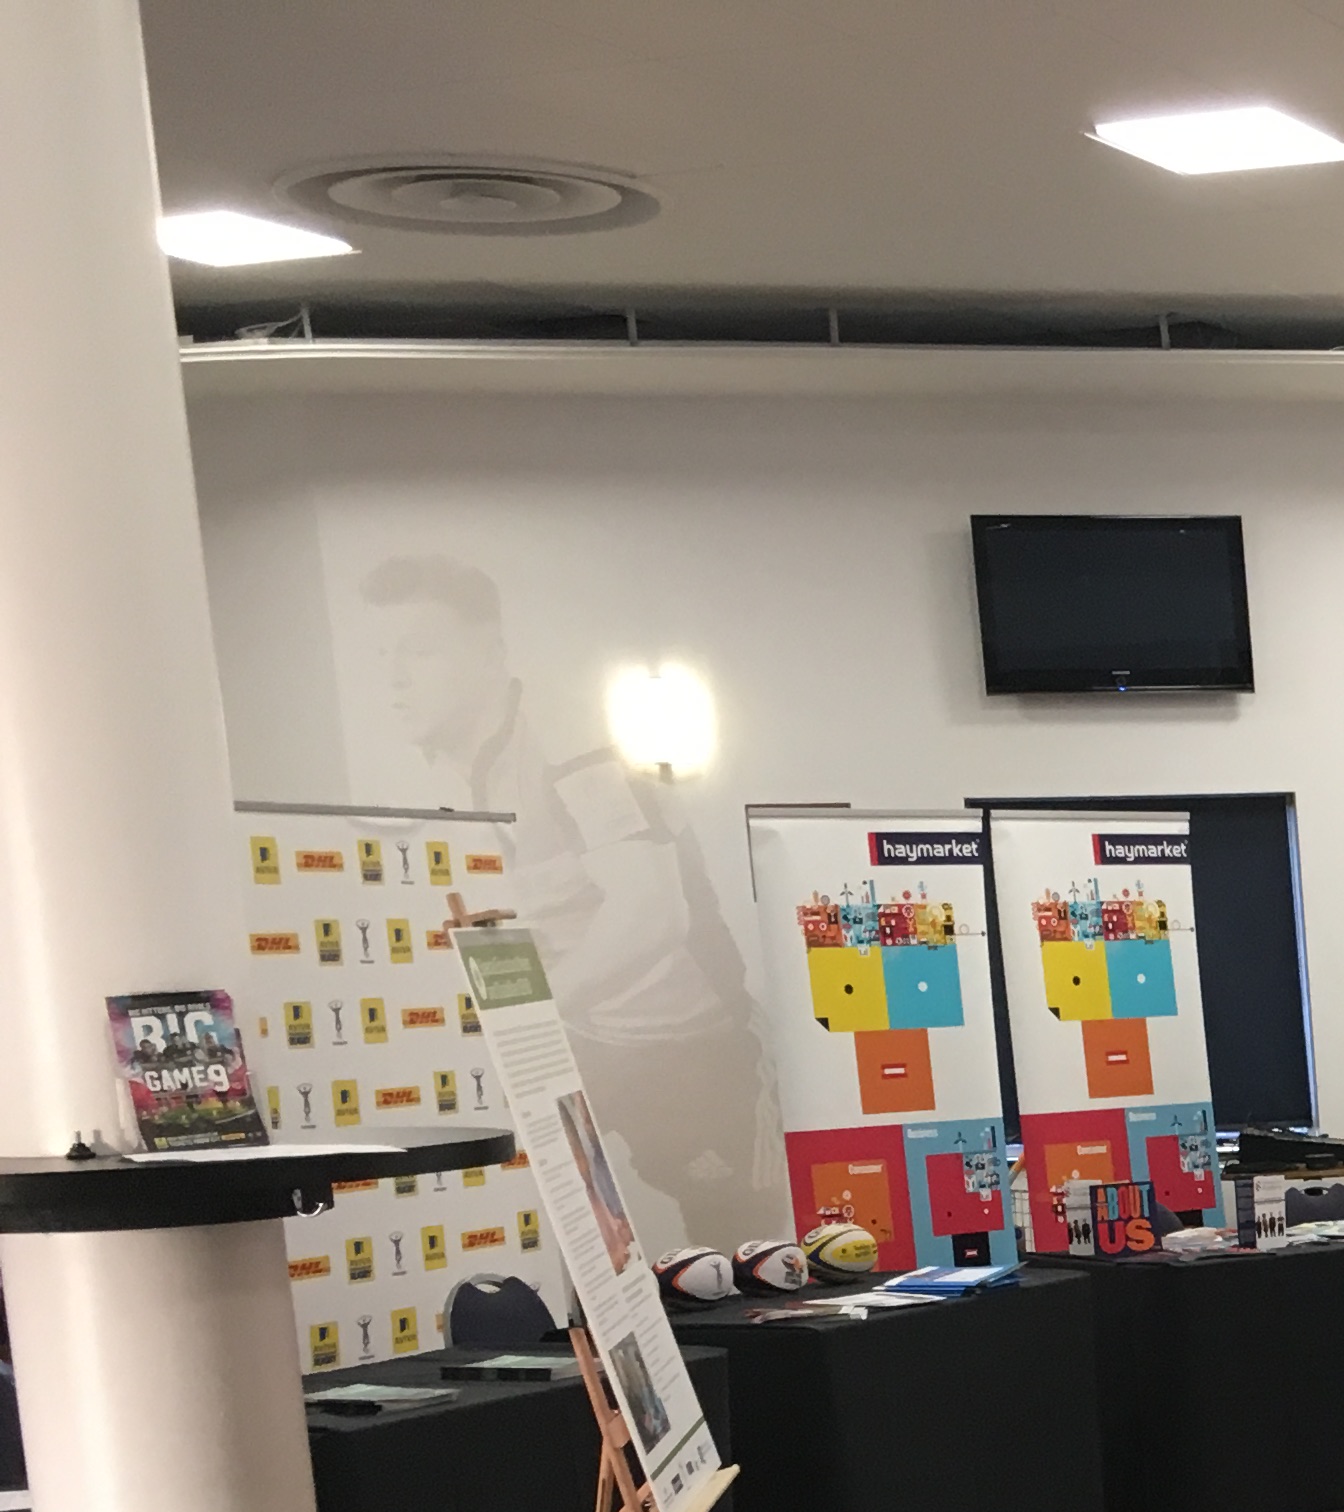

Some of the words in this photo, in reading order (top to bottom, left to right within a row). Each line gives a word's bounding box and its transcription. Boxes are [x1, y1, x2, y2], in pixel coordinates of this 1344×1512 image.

[883, 839, 979, 862] haymarket
[1105, 840, 1187, 862] haymarket
[303, 854, 337, 868] DHL
[472, 858, 497, 871] DHL
[256, 937, 292, 951] DHL
[408, 1010, 438, 1025] DHL
[144, 1066, 209, 1092] GAME
[206, 1063, 230, 1092] 9
[382, 1090, 415, 1106] DHL
[1096, 1184, 1150, 1222] ABOUT
[467, 1230, 499, 1248] DHL
[1097, 1219, 1155, 1254] US
